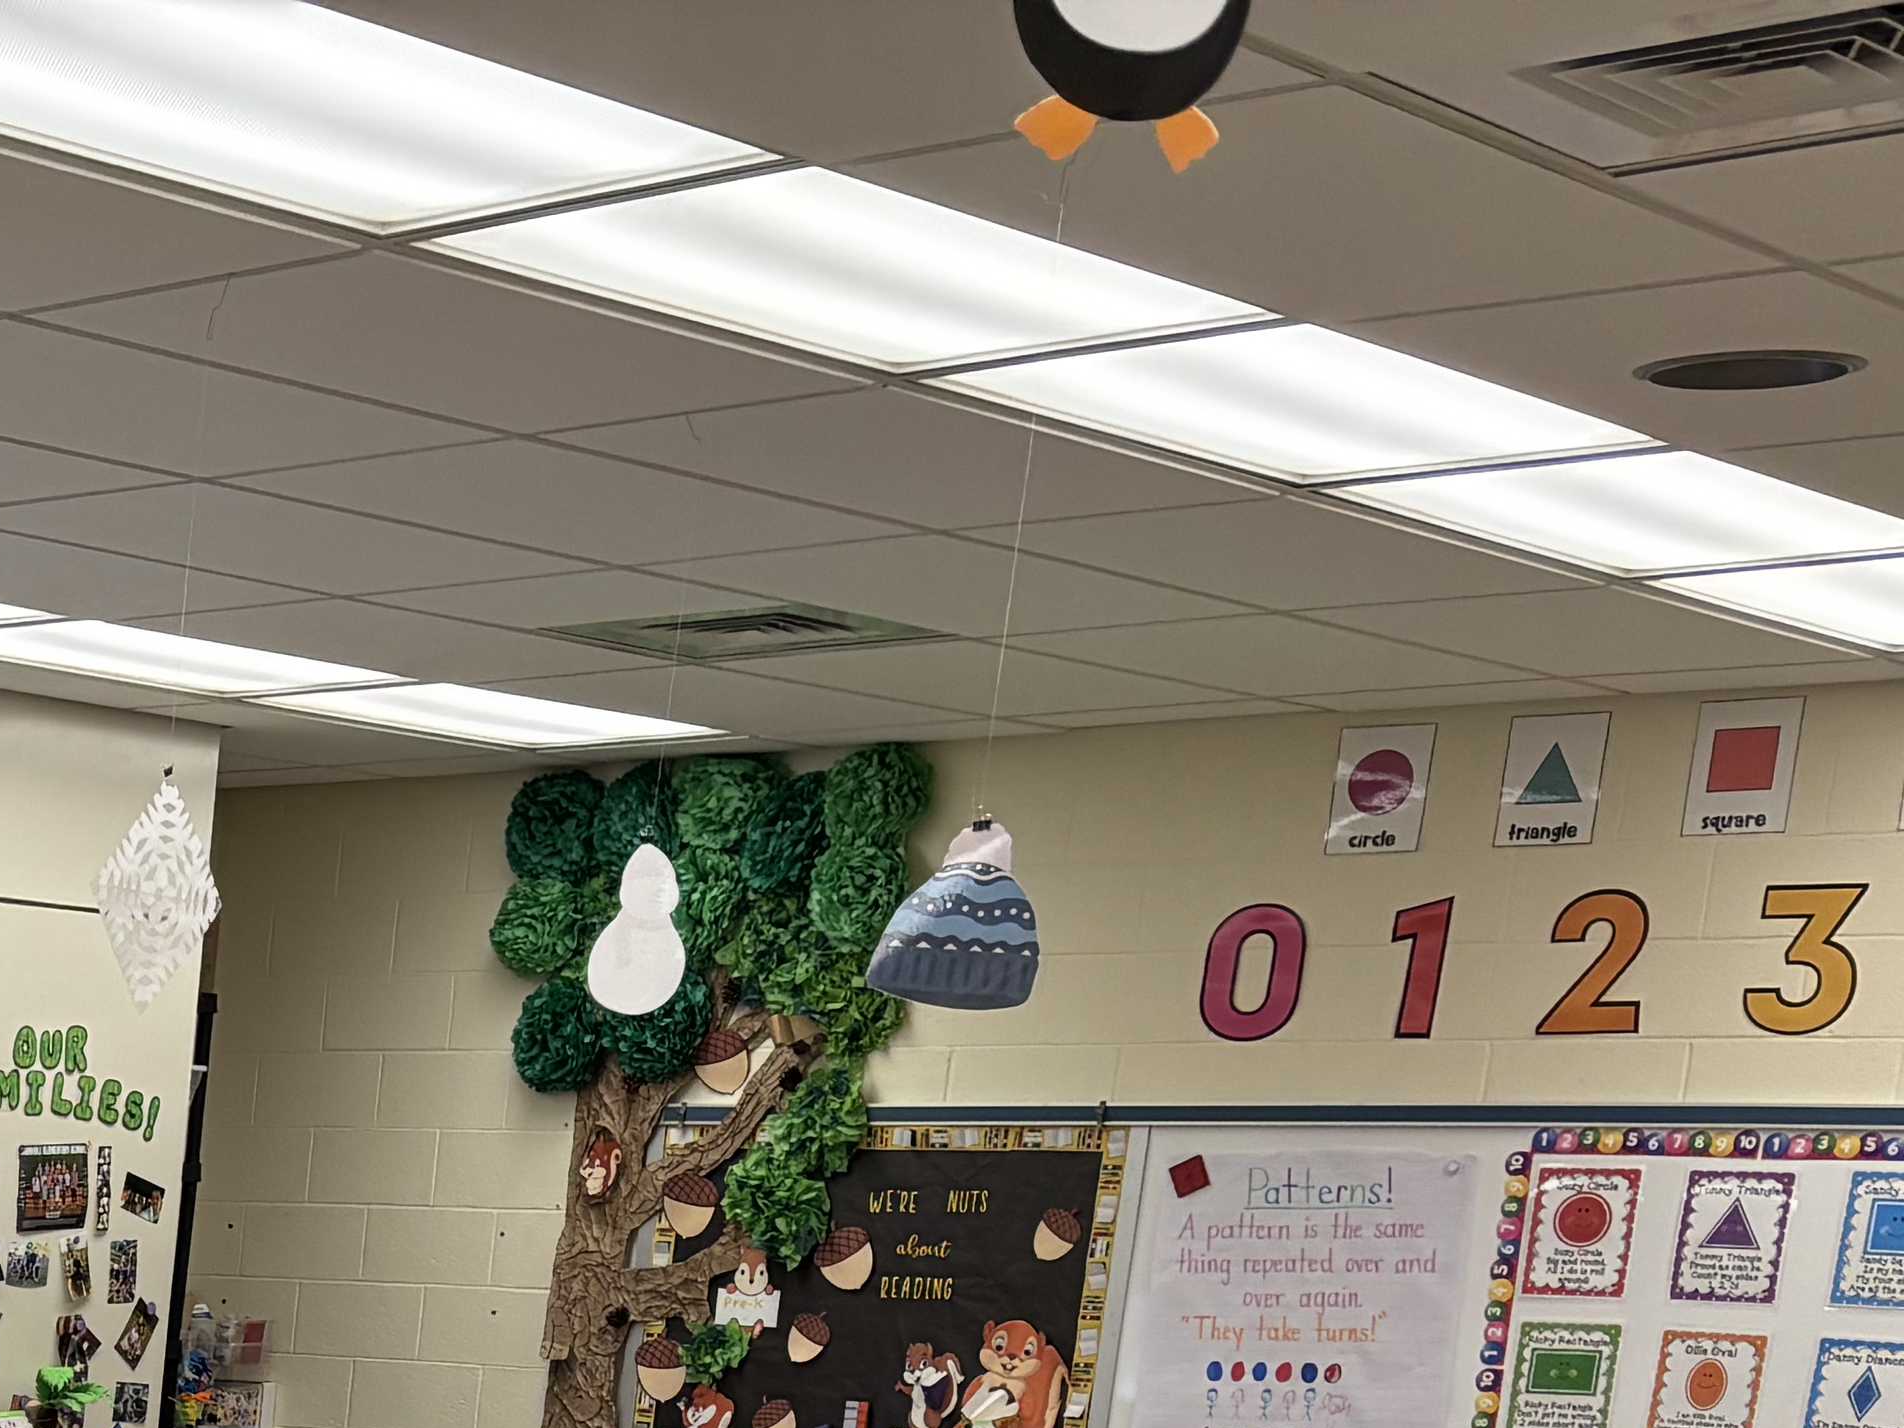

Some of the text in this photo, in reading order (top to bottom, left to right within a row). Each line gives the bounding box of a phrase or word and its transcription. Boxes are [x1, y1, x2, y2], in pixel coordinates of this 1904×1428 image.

[1508, 822, 1578, 840] triangle
[1701, 813, 1766, 832] square
[1348, 831, 1396, 848] circle
[1199, 883, 1870, 1042] 0 1 2 3
[12, 1025, 88, 1073] OUR
[1542, 1131, 1899, 1156] 1 2 3 4 5 6 7 8 9 10 1 2 3 4 5 6
[1247, 1165, 1393, 1206] Patterns!
[868, 1189, 989, 1214] WE'RE NUTS
[1178, 1213, 1425, 1251] A pattern is the same
[895, 1233, 953, 1259] about
[1178, 1248, 1437, 1285] thing repeated over and
[880, 1275, 954, 1300] READING
[1243, 1287, 1363, 1315] over again.
[1257, 1315, 1300, 1342] take
